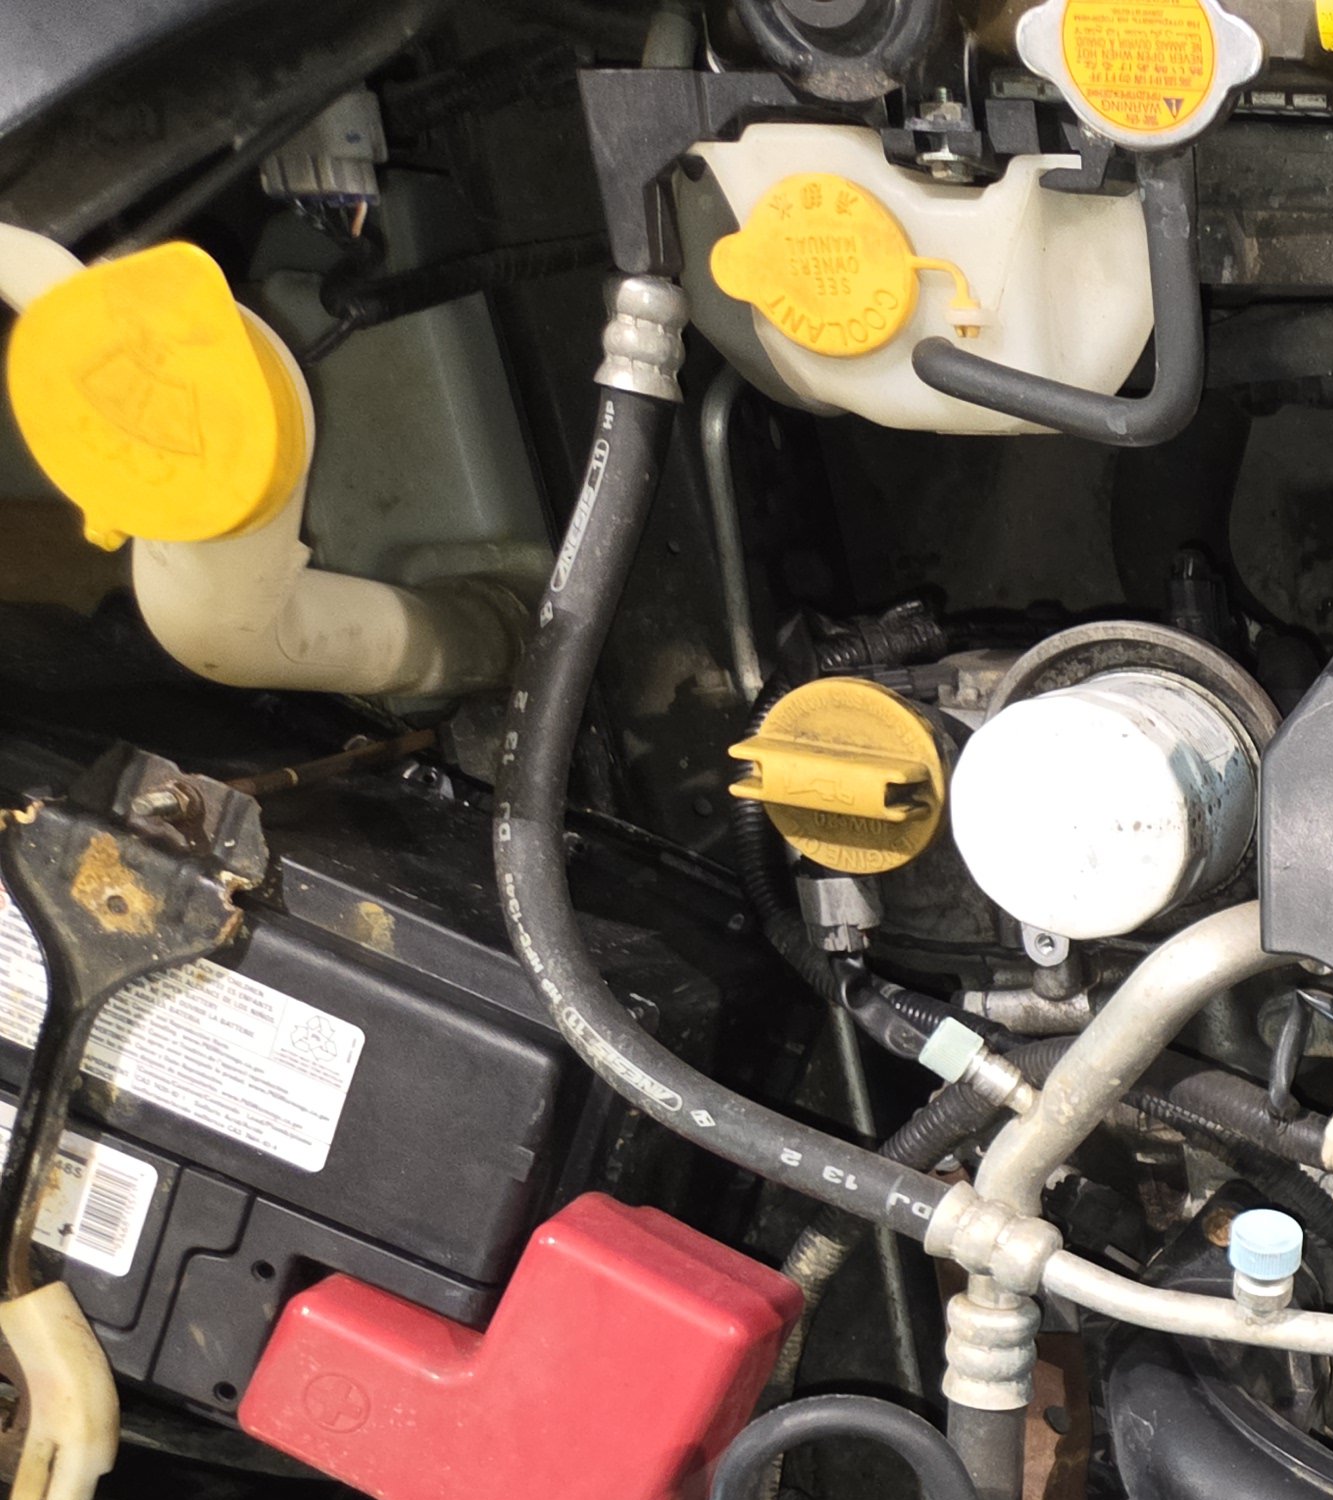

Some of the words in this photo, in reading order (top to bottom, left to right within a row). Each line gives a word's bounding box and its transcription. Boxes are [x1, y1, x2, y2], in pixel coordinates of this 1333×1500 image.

[1155, 40, 1186, 51] JAMAIS
[1101, 50, 1132, 62] WHEN
[1136, 51, 1164, 62] OPEN
[1170, 54, 1203, 64] NEVER
[1101, 100, 1161, 113] WARNING
[784, 235, 856, 253] MANUAL
[789, 256, 858, 276] OWNERS
[815, 277, 851, 296] SEE
[764, 289, 898, 347] COOLANT
[601, 400, 615, 430] HP
[540, 977, 563, 1004] HP
[779, 1147, 803, 1168] 2
[822, 1165, 858, 1190] 13
